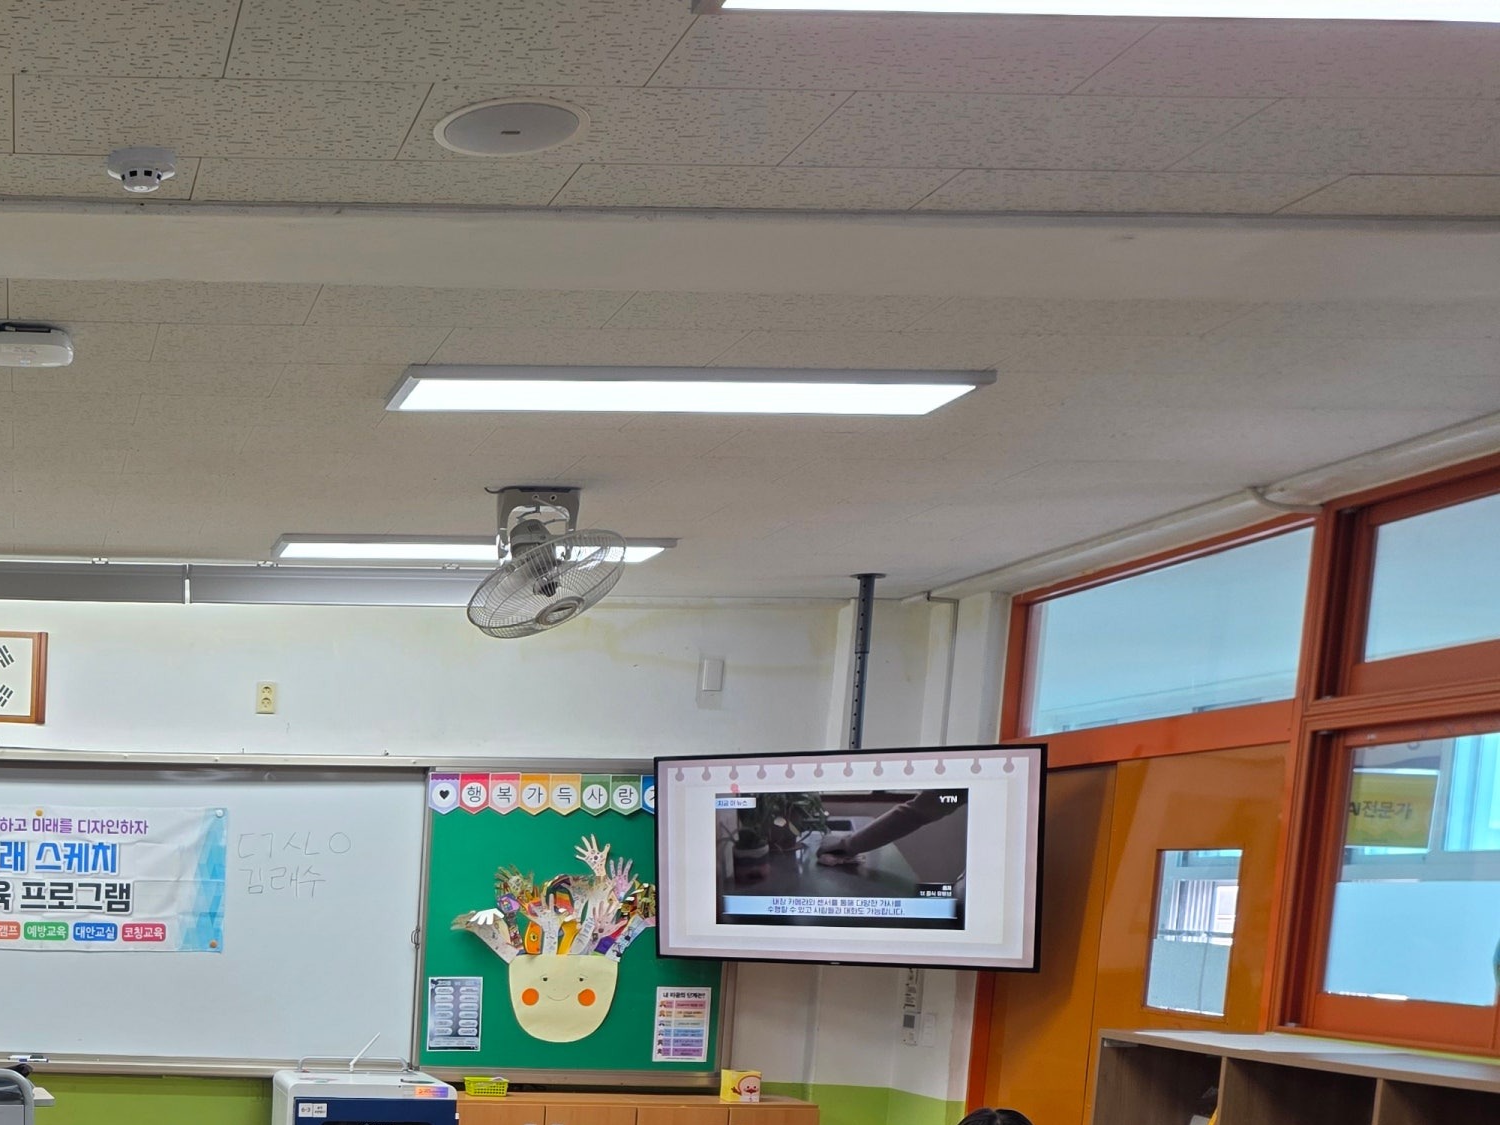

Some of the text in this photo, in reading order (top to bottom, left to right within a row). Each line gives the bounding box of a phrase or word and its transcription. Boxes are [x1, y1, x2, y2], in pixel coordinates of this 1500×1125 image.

[939, 795, 958, 803] YTN
[32, 817, 73, 834] 미래를
[77, 819, 150, 835] 디자인하자
[35, 842, 118, 874] 스케치
[20, 881, 132, 913] 프로그램
[26, 924, 67, 939] 예방교육
[75, 925, 116, 940] 대안교실
[123, 926, 165, 941] 코칭교육
